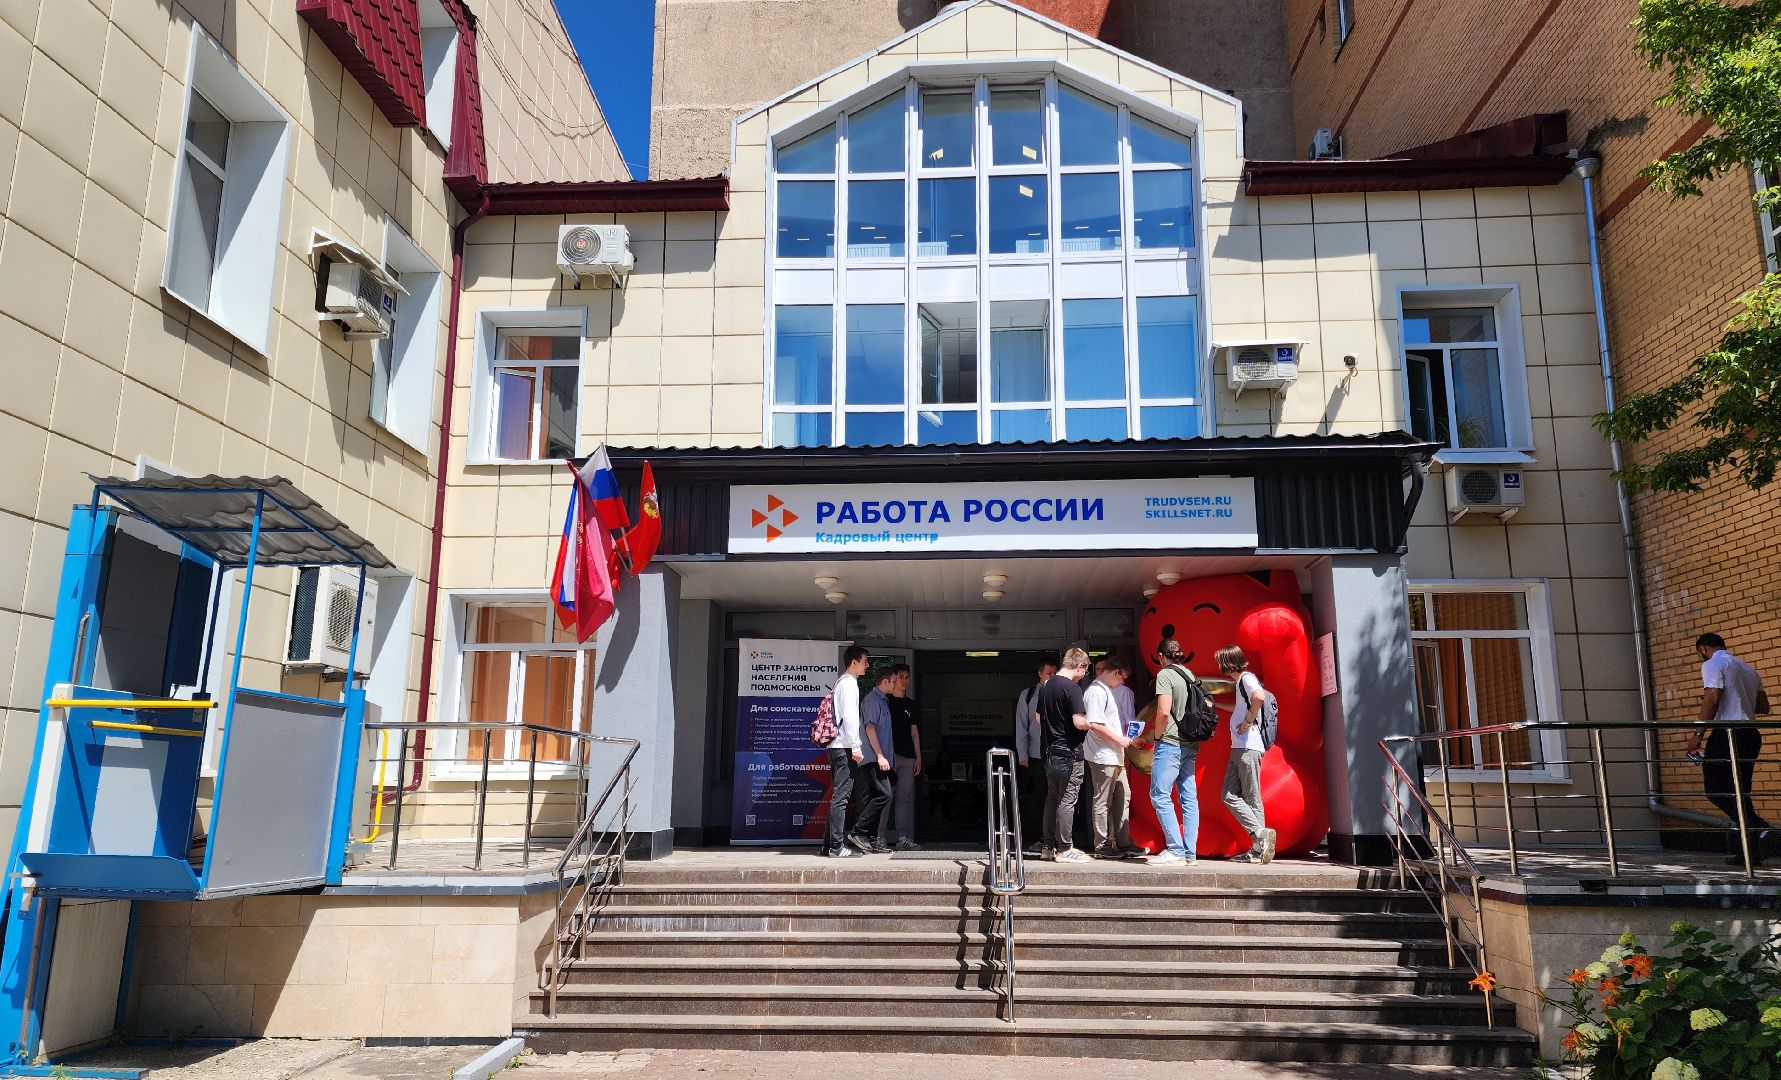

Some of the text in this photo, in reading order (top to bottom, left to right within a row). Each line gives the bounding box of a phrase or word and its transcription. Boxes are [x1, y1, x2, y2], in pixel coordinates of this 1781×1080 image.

[1145, 496, 1232, 507] TRUDVSEM.RU
[816, 498, 1104, 524] РАБОТА РОССИИ
[1145, 508, 1233, 519] SKILLSNET.RU
[815, 530, 938, 545] Кадровый центр
[751, 664, 838, 673] ЦЕНТР ЗАНЯТОСТИ
[751, 674, 807, 682] НАСЕЛЕНИЯ
[750, 683, 821, 692] ПОДМОСКОВЬЯ
[750, 704, 769, 713] Для
[747, 763, 832, 773] Для работодателе
